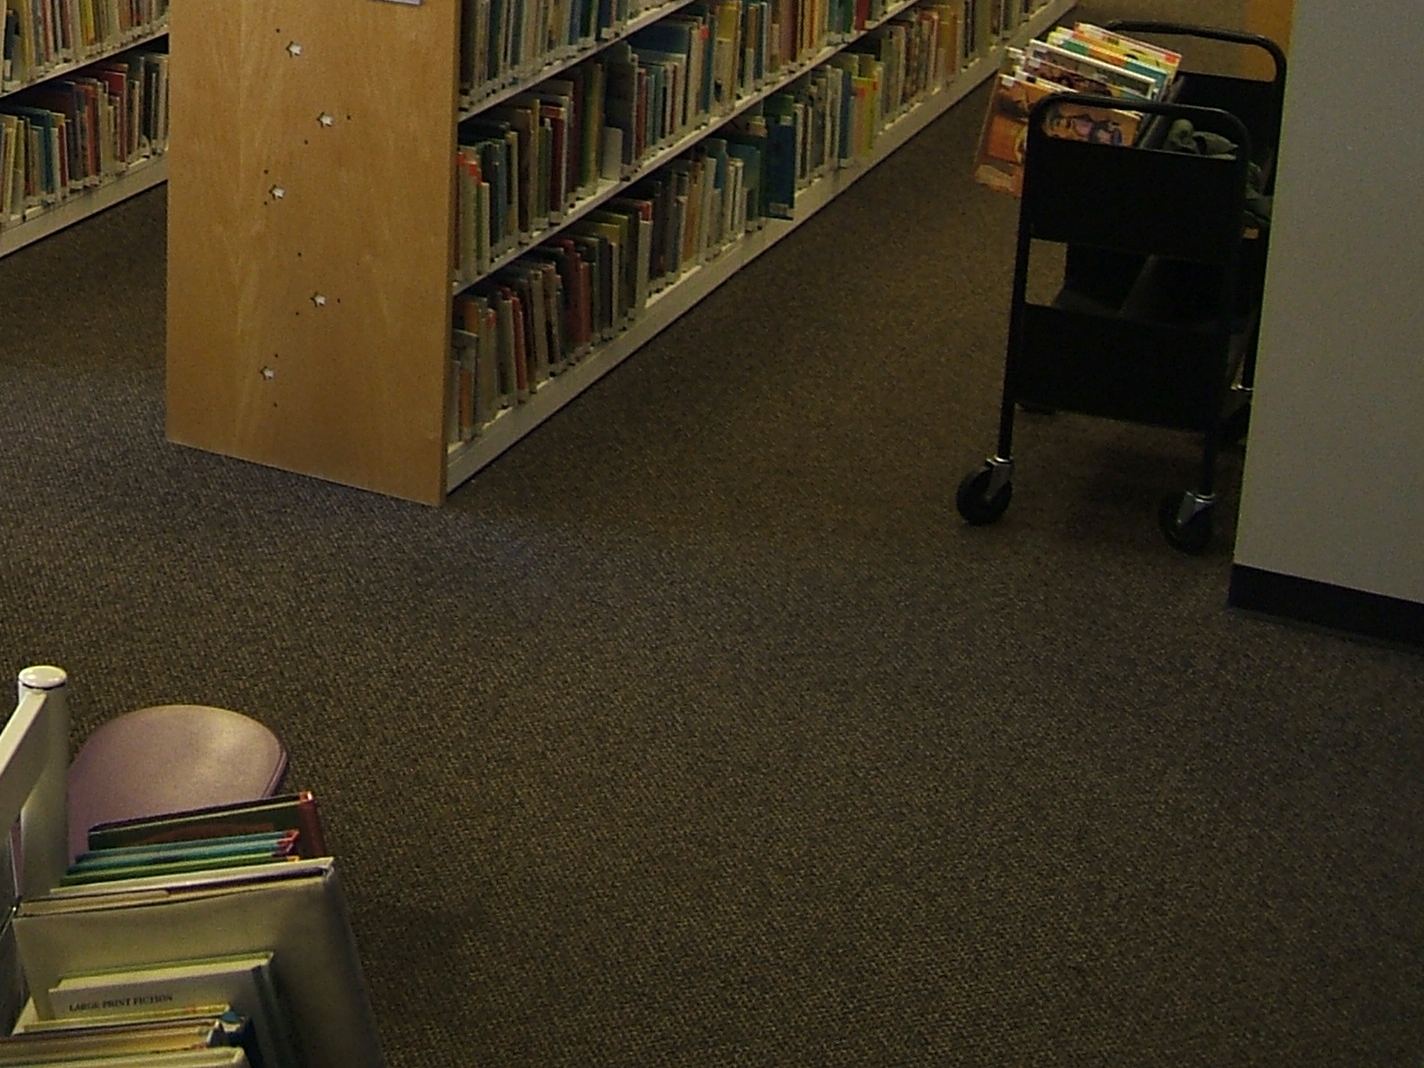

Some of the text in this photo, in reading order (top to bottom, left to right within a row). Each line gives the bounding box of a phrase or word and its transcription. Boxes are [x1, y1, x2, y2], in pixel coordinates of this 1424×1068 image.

[69, 994, 174, 1012] LARGE PRINT FICTION
